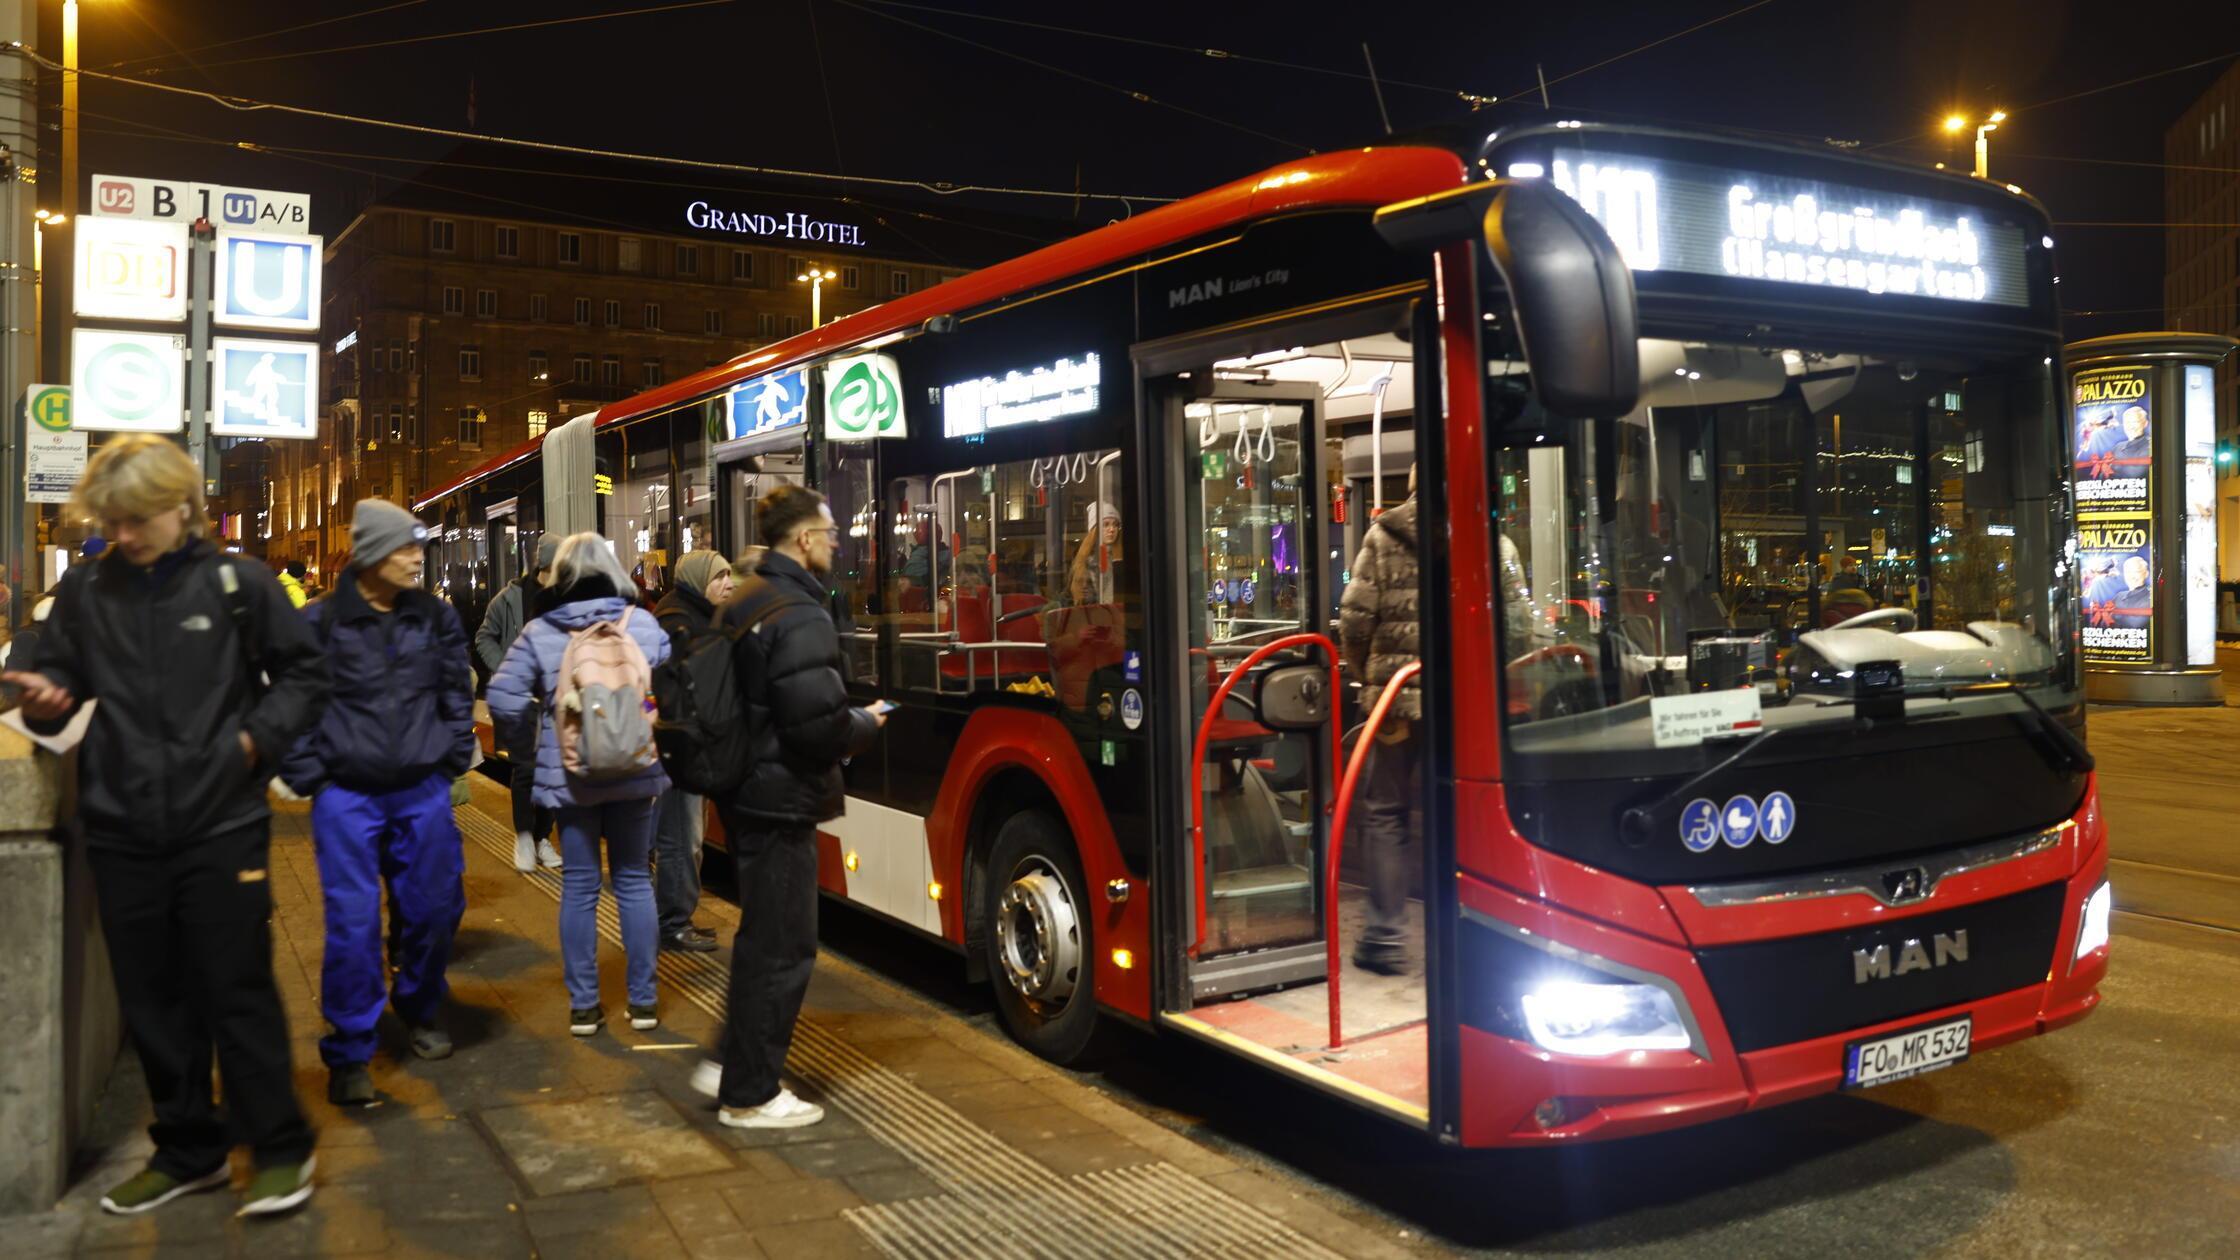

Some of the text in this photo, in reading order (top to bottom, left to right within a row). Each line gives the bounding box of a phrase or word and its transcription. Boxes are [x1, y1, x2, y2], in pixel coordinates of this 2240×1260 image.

[100, 187, 133, 209] U2
[153, 186, 177, 217] B
[225, 198, 256, 220] U1
[261, 203, 305, 223] A/B
[234, 241, 303, 316] U
[1168, 269, 1290, 309] MAN Lion's City
[103, 351, 162, 411] S
[46, 397, 71, 422] H
[1853, 929, 1969, 984] MAN
[1860, 1044, 1889, 1078] FO
[1901, 1034, 1928, 1067] MR
[1932, 1023, 1968, 1058] 532
